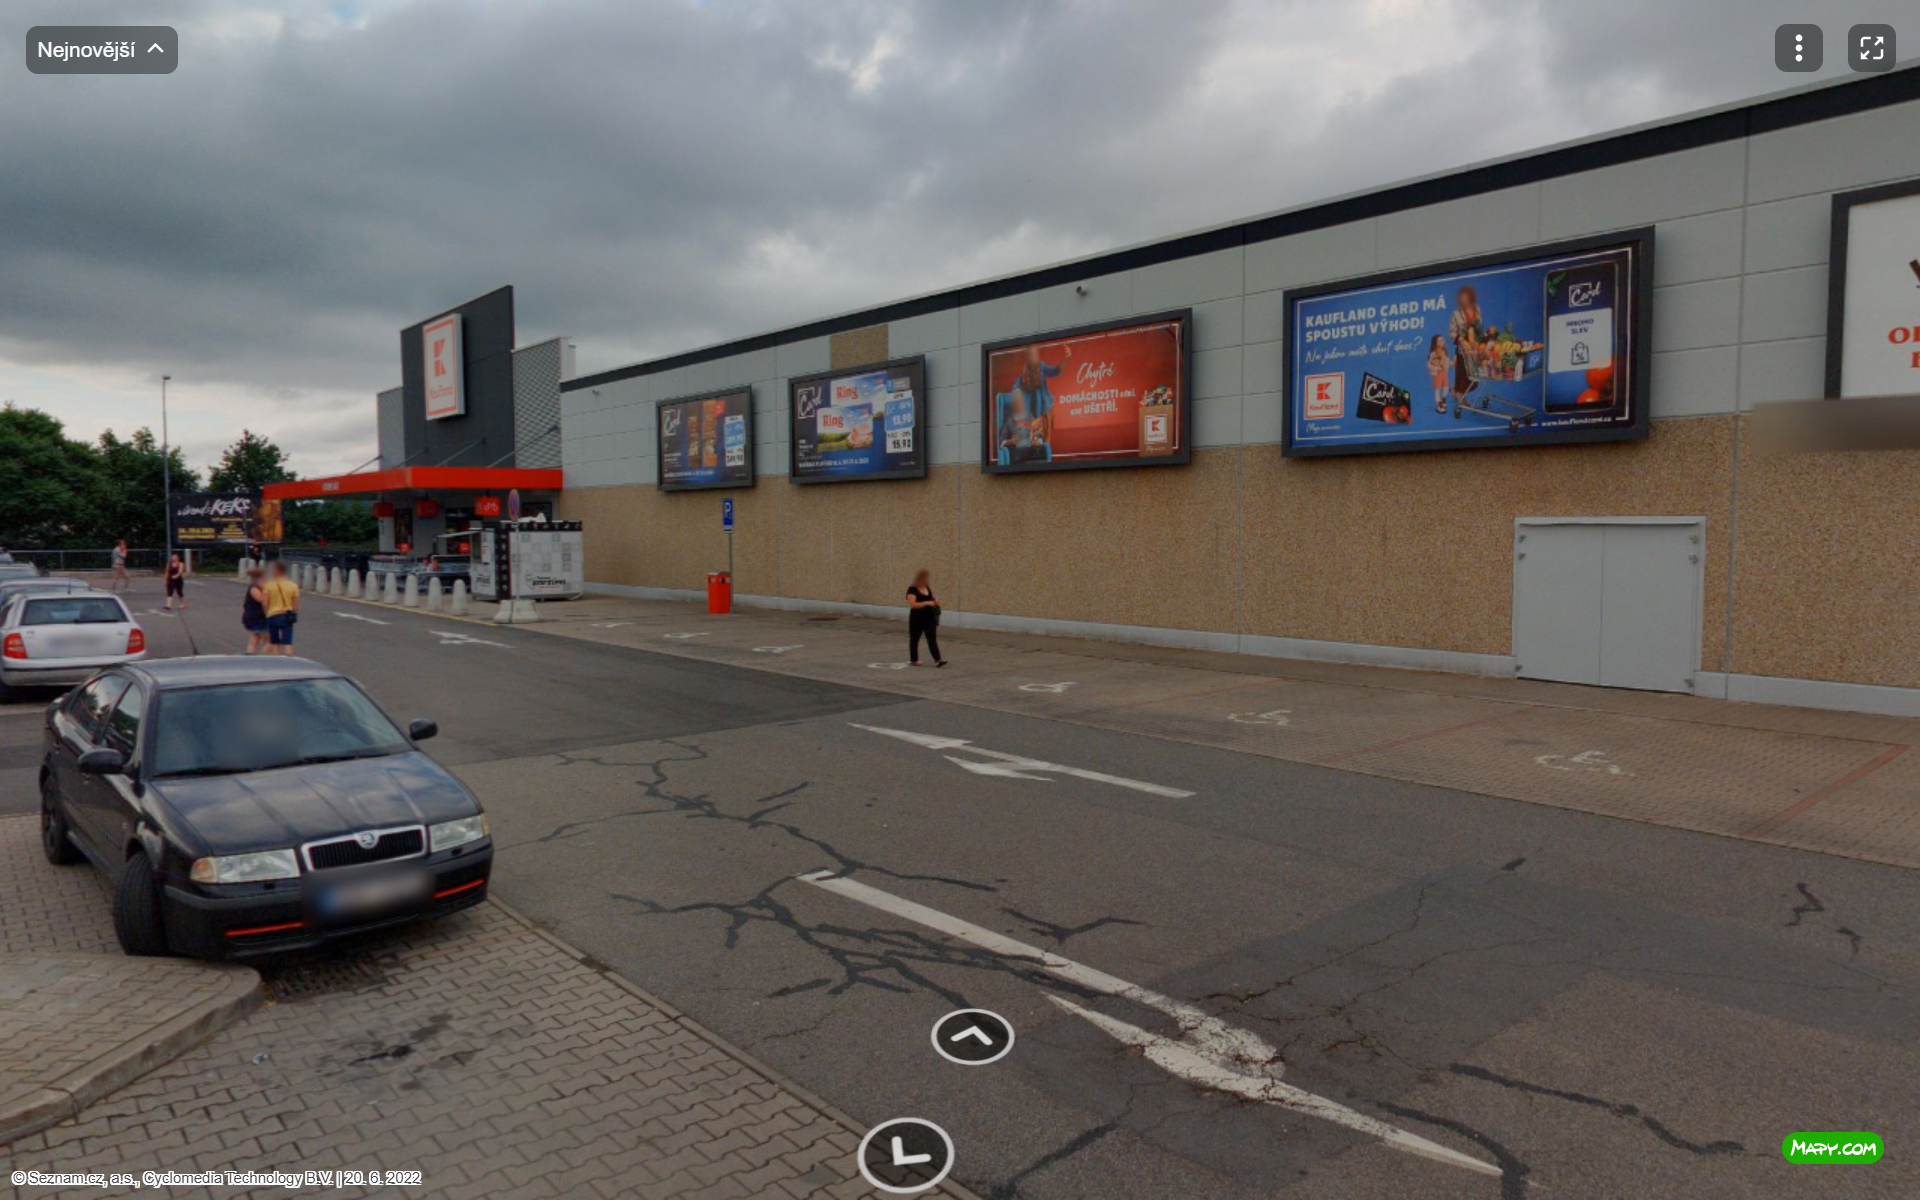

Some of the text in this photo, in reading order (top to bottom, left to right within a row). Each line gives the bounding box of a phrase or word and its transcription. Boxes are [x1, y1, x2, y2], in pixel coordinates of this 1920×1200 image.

[1571, 281, 1602, 306] Card
[1305, 294, 1447, 328] KAUFLAND CARD MÁ
[1305, 316, 1425, 343] SPOUSTU VÝHOD!
[1566, 318, 1594, 328] MNOHO
[1571, 326, 1589, 335] SLEV
[1076, 361, 1114, 388] Chytré
[836, 386, 859, 399] Ring
[1059, 388, 1118, 404] DOMÁCNOSTI
[1316, 381, 1332, 401] K
[1367, 383, 1396, 400] Card
[1083, 399, 1118, 414] UŠETŘÍ.
[1309, 403, 1338, 411] Kaufland
[823, 414, 844, 428] Ring
